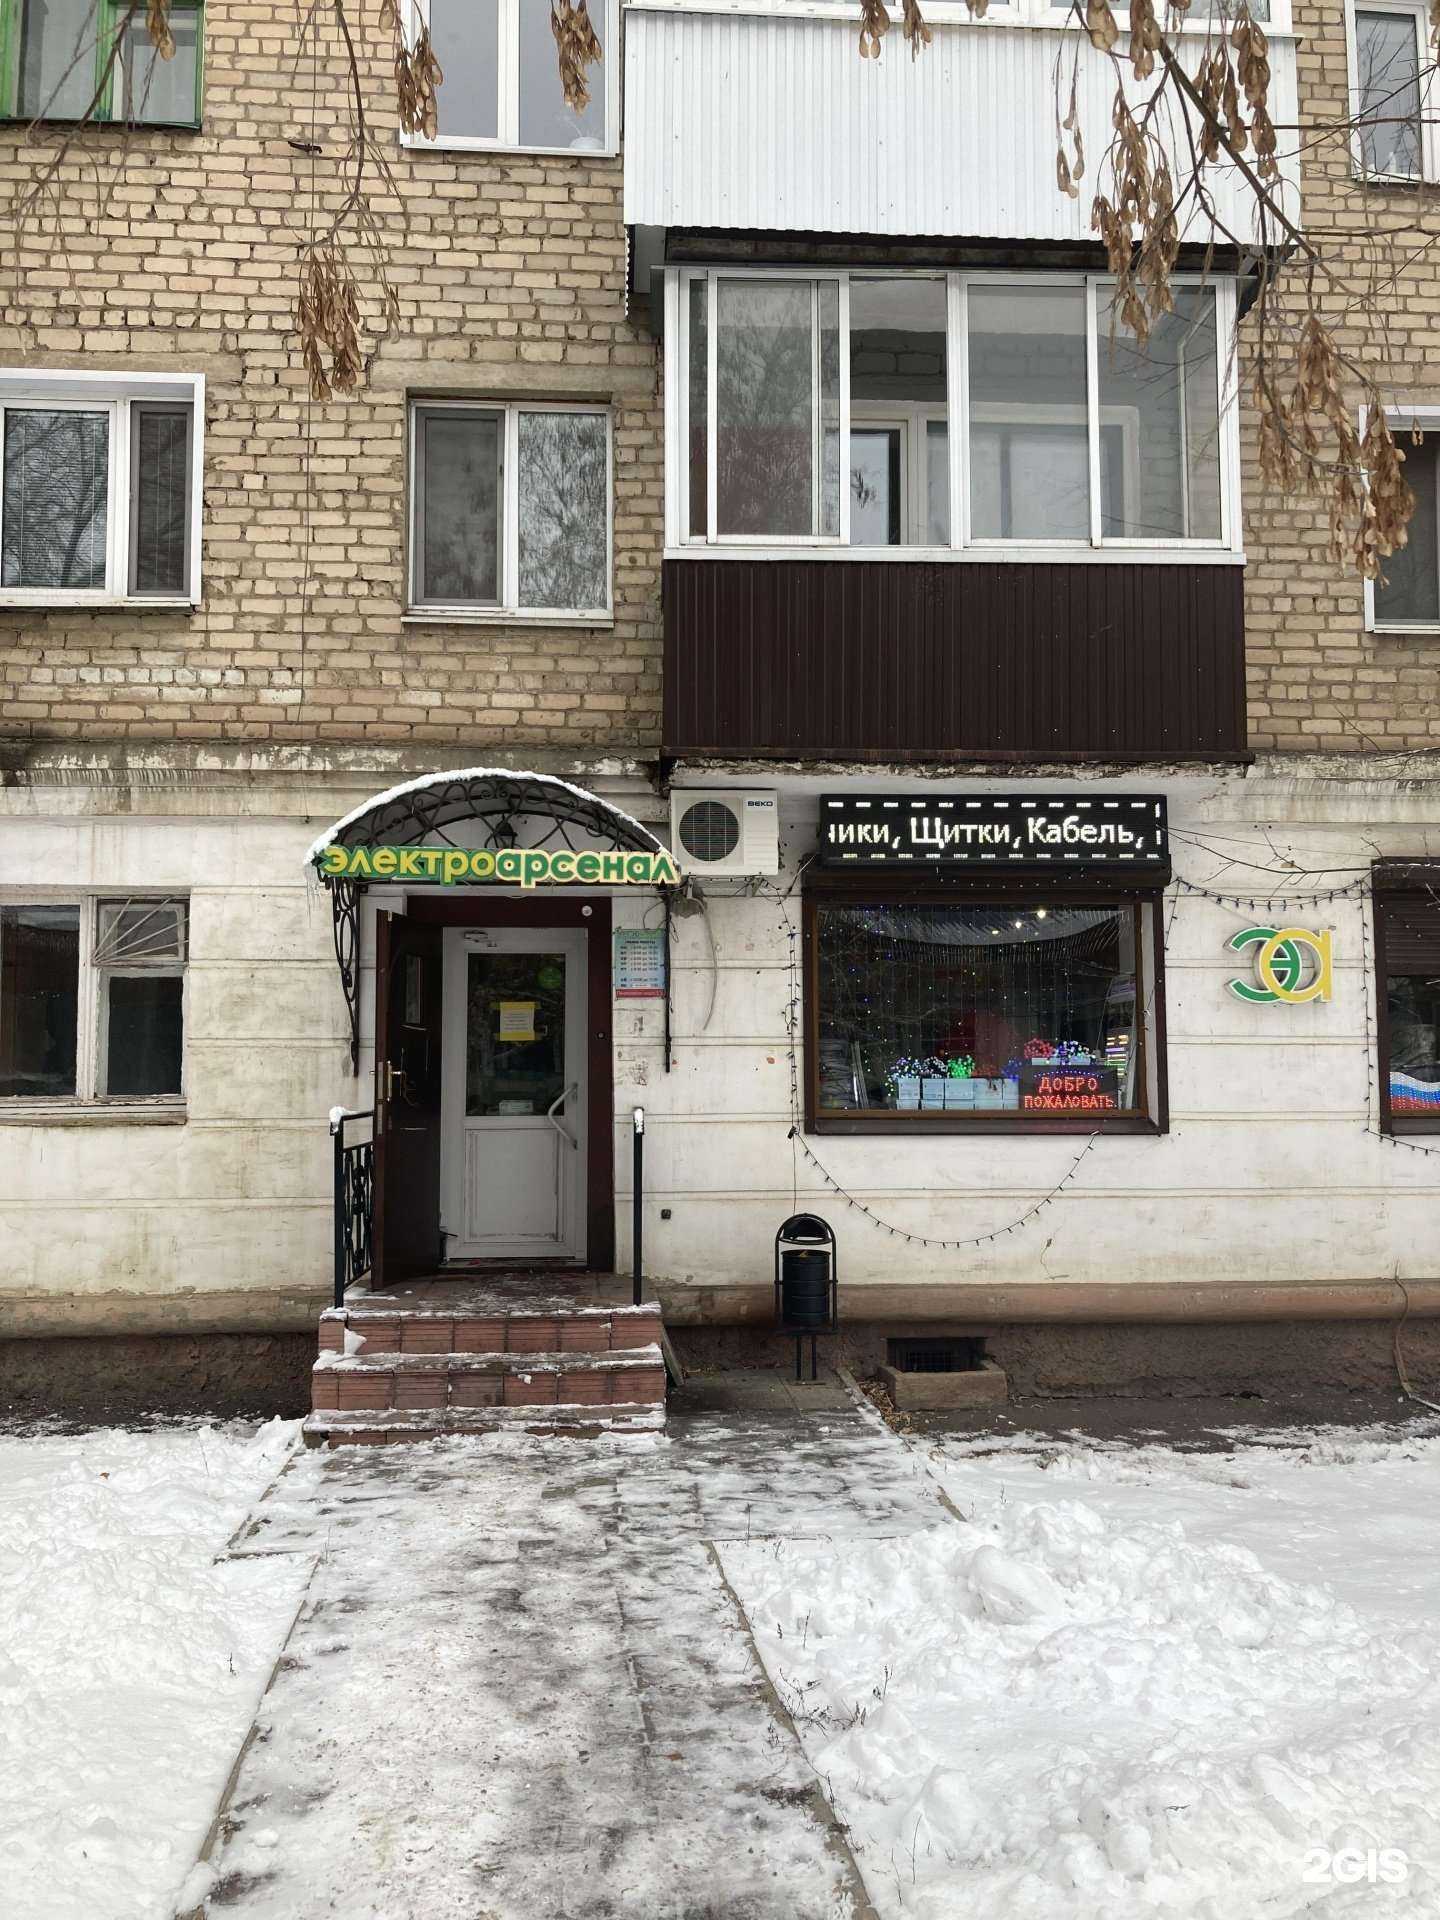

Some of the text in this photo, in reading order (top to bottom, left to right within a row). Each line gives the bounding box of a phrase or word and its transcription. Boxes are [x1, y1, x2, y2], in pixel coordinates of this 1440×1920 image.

[910, 816, 1021, 849] Щитки,
[1027, 815, 1144, 849] Кабель,
[1038, 1076, 1098, 1093] ДОБРО
[1024, 1094, 1115, 1109] ПОЖАЛОВАТЬ
